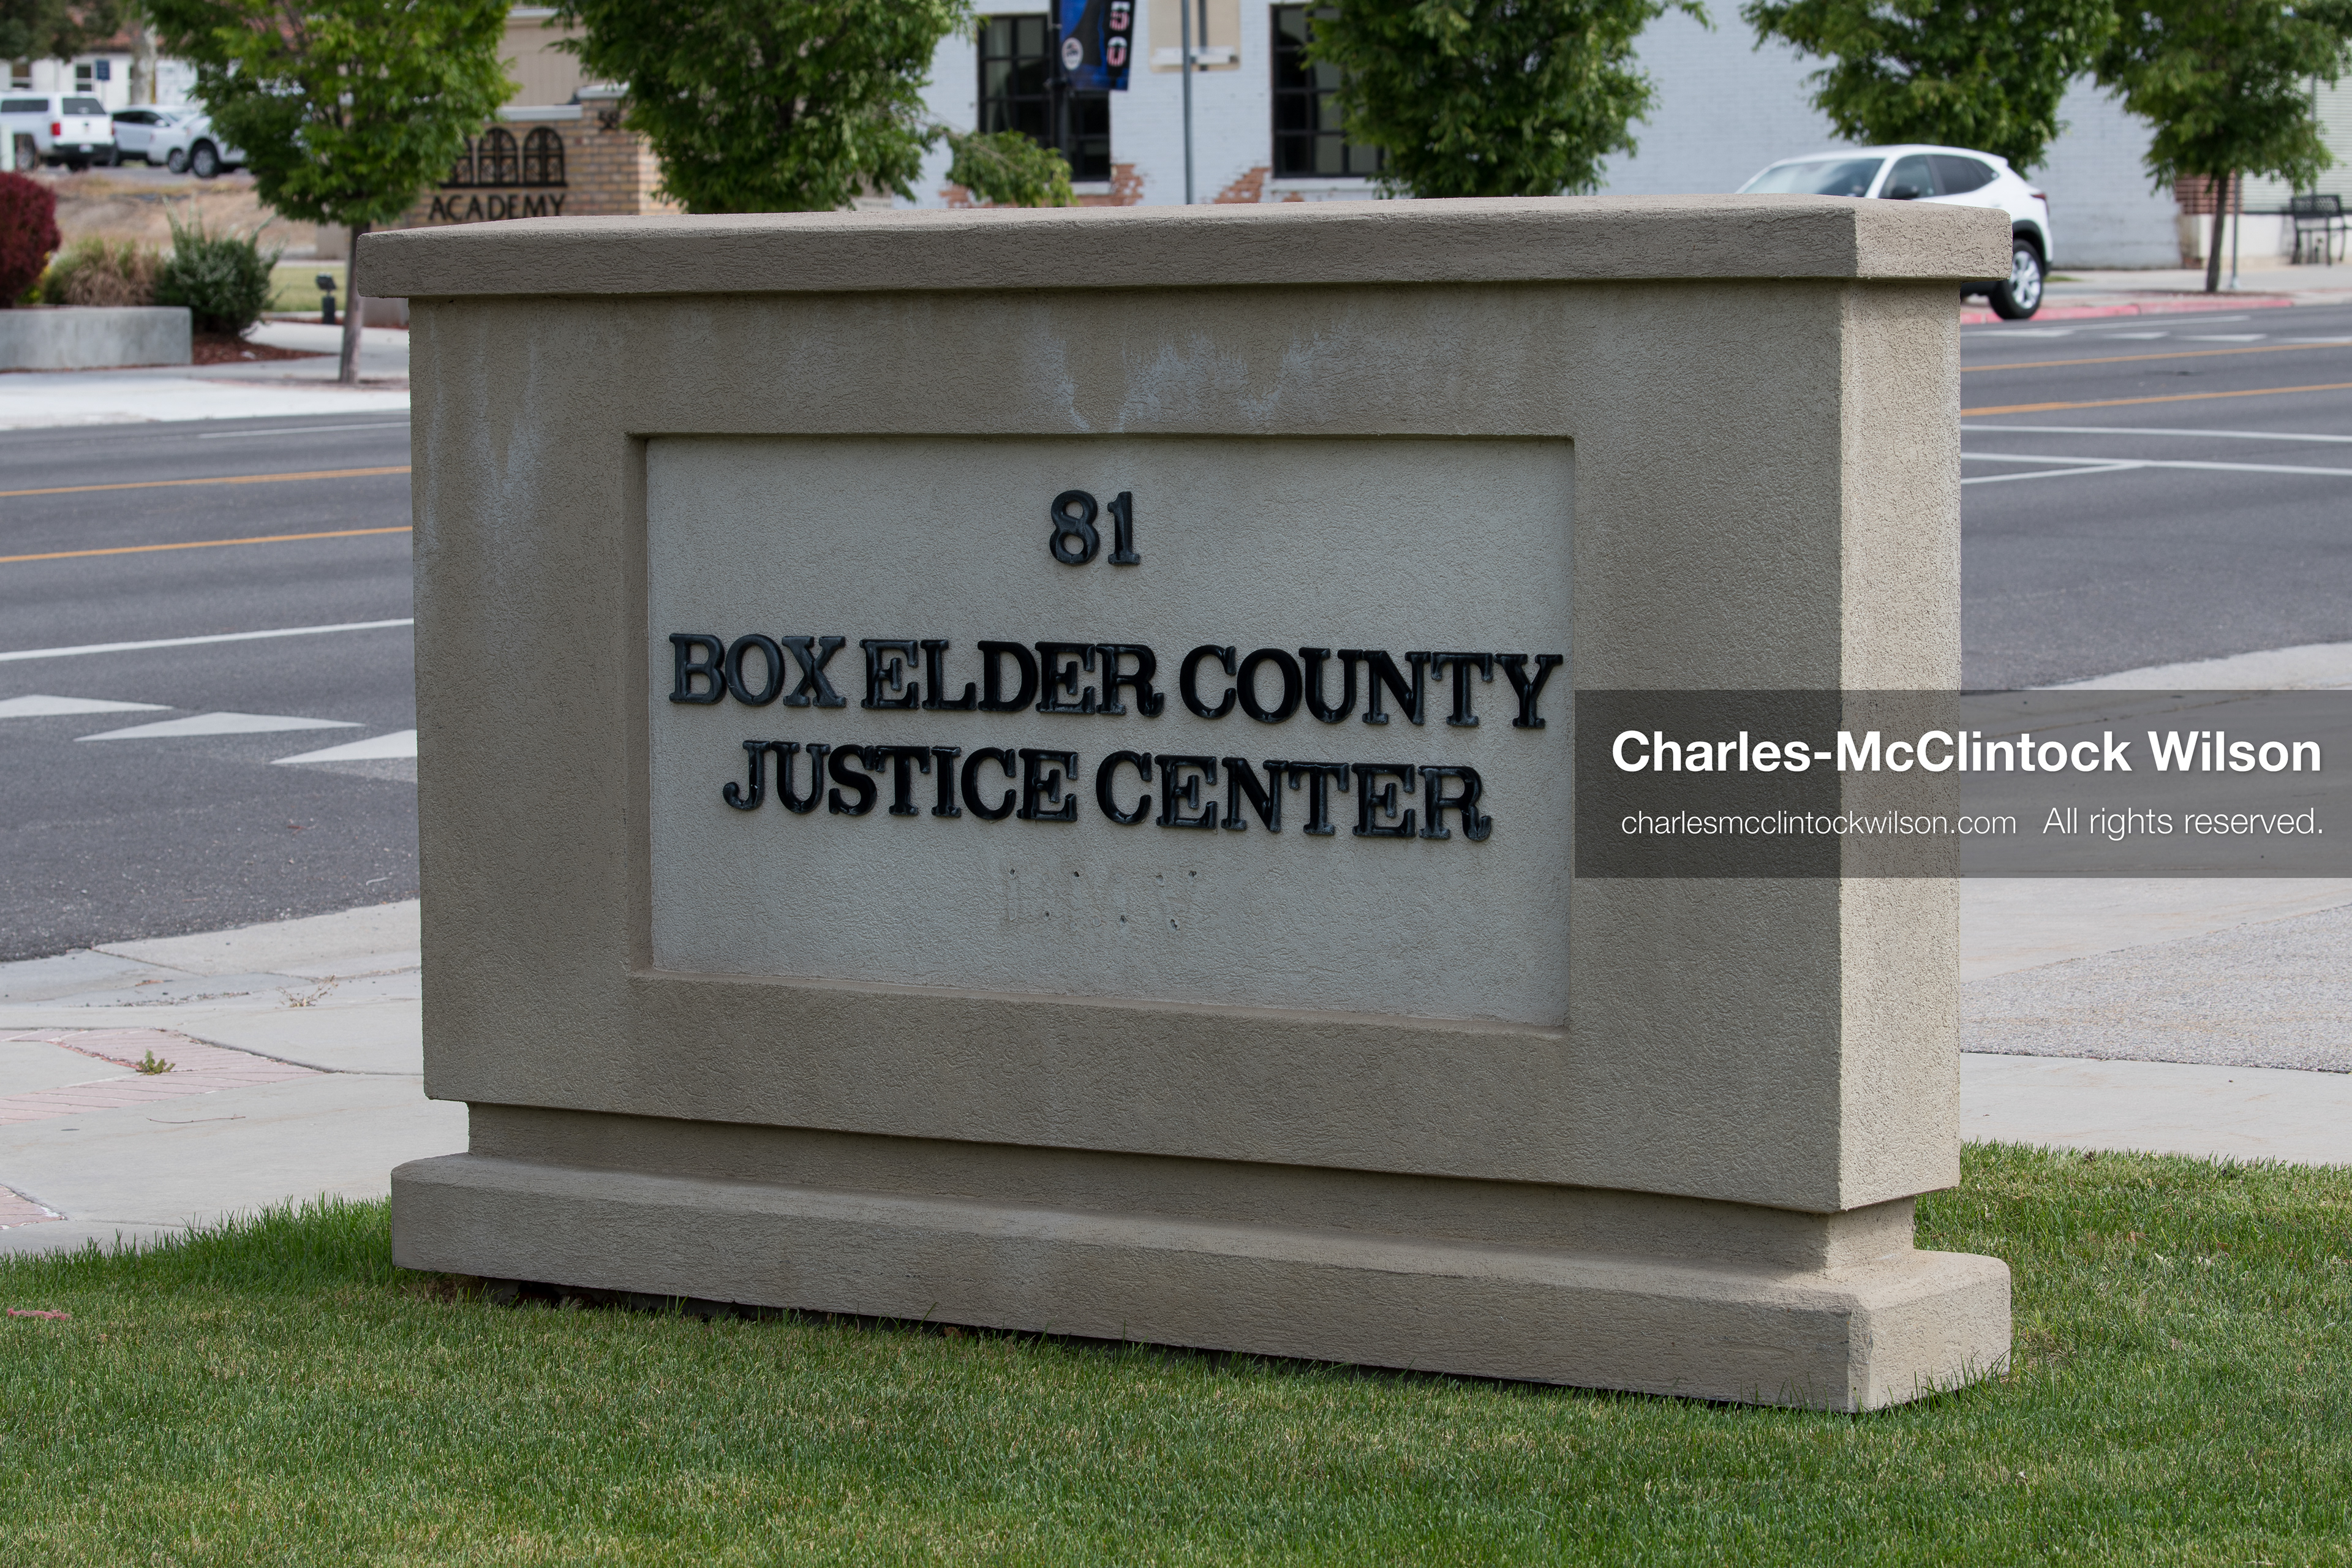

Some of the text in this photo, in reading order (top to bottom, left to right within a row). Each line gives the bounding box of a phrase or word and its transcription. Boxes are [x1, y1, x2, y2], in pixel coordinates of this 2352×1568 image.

[428, 194, 565, 221] ACADEMY
[1049, 490, 1140, 565] 81
[669, 633, 1564, 729] BOX ELDER COUNTY
[723, 740, 1491, 842] JUSTICE CENTER
